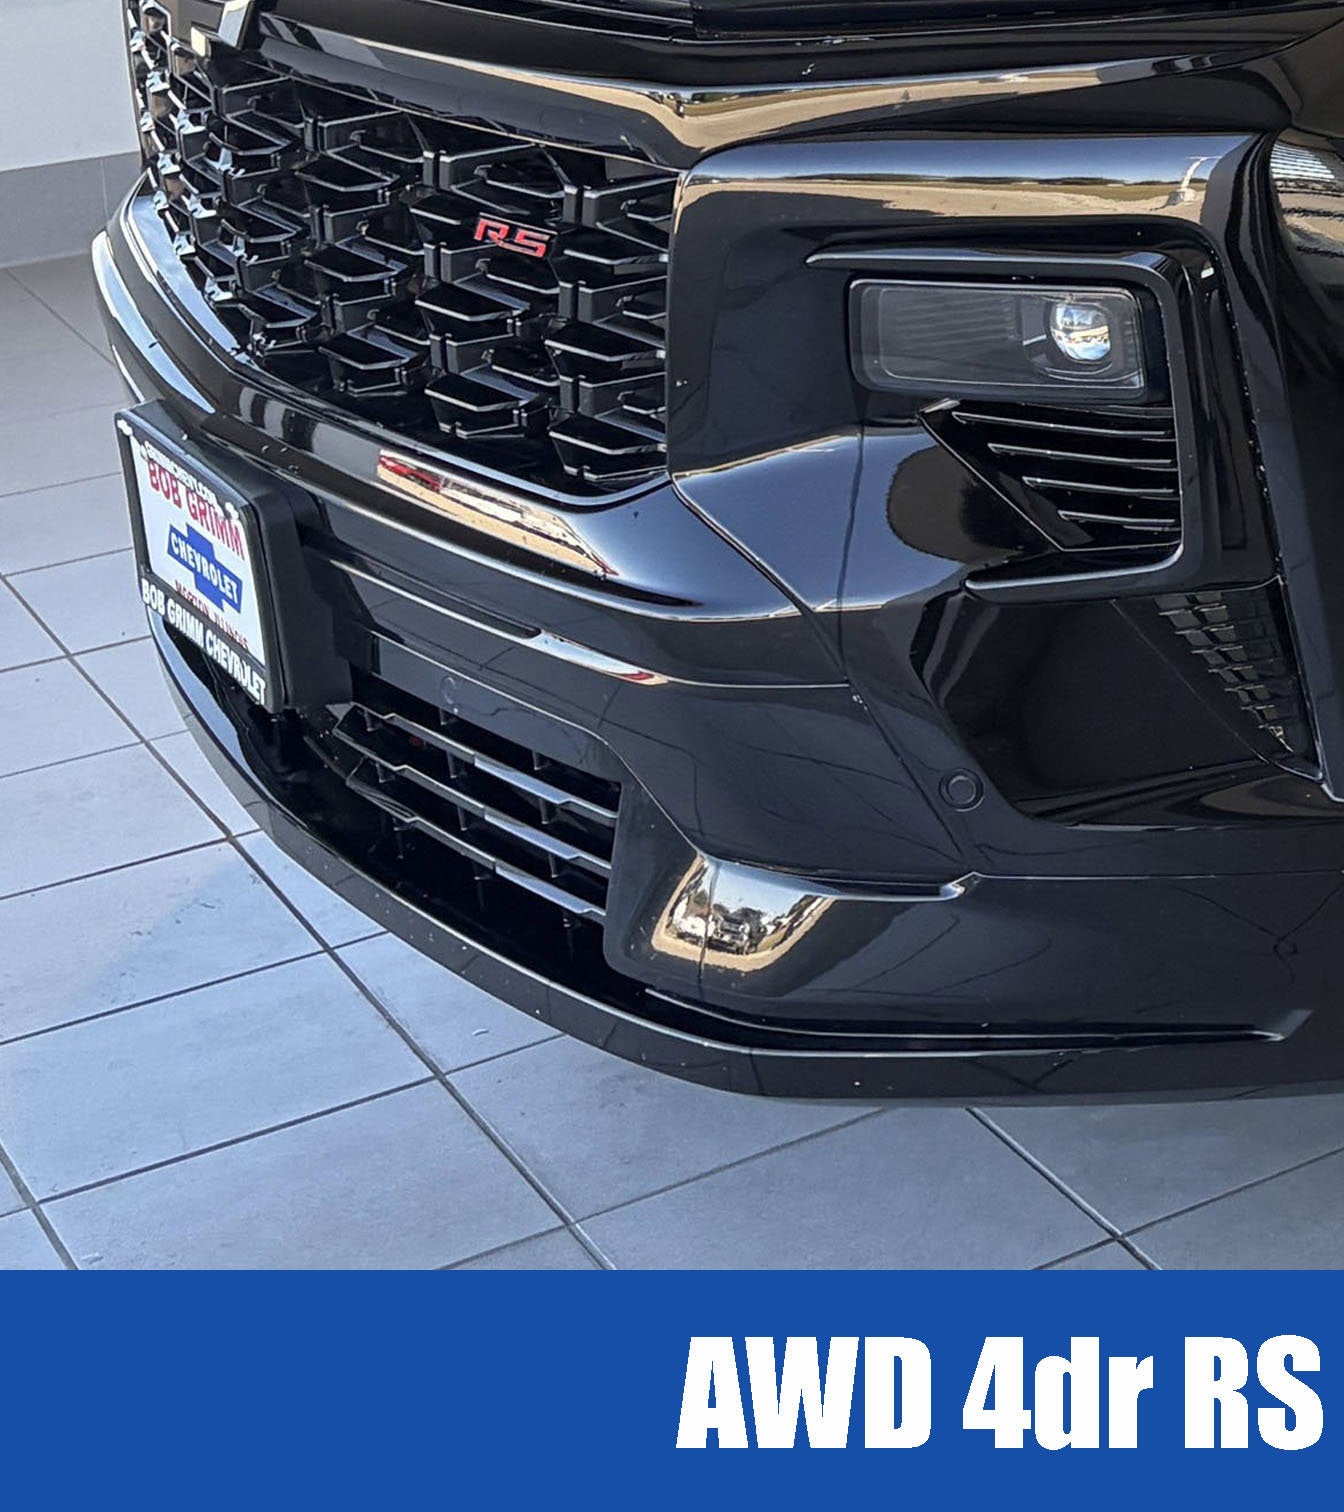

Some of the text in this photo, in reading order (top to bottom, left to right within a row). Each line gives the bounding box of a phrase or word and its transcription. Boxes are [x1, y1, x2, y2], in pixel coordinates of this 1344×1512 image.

[473, 217, 551, 258] RS
[148, 460, 245, 562] BOB GRIMM
[170, 532, 240, 605] CHEVROLET
[140, 576, 267, 707] BOB GRIMM CHEVROLET
